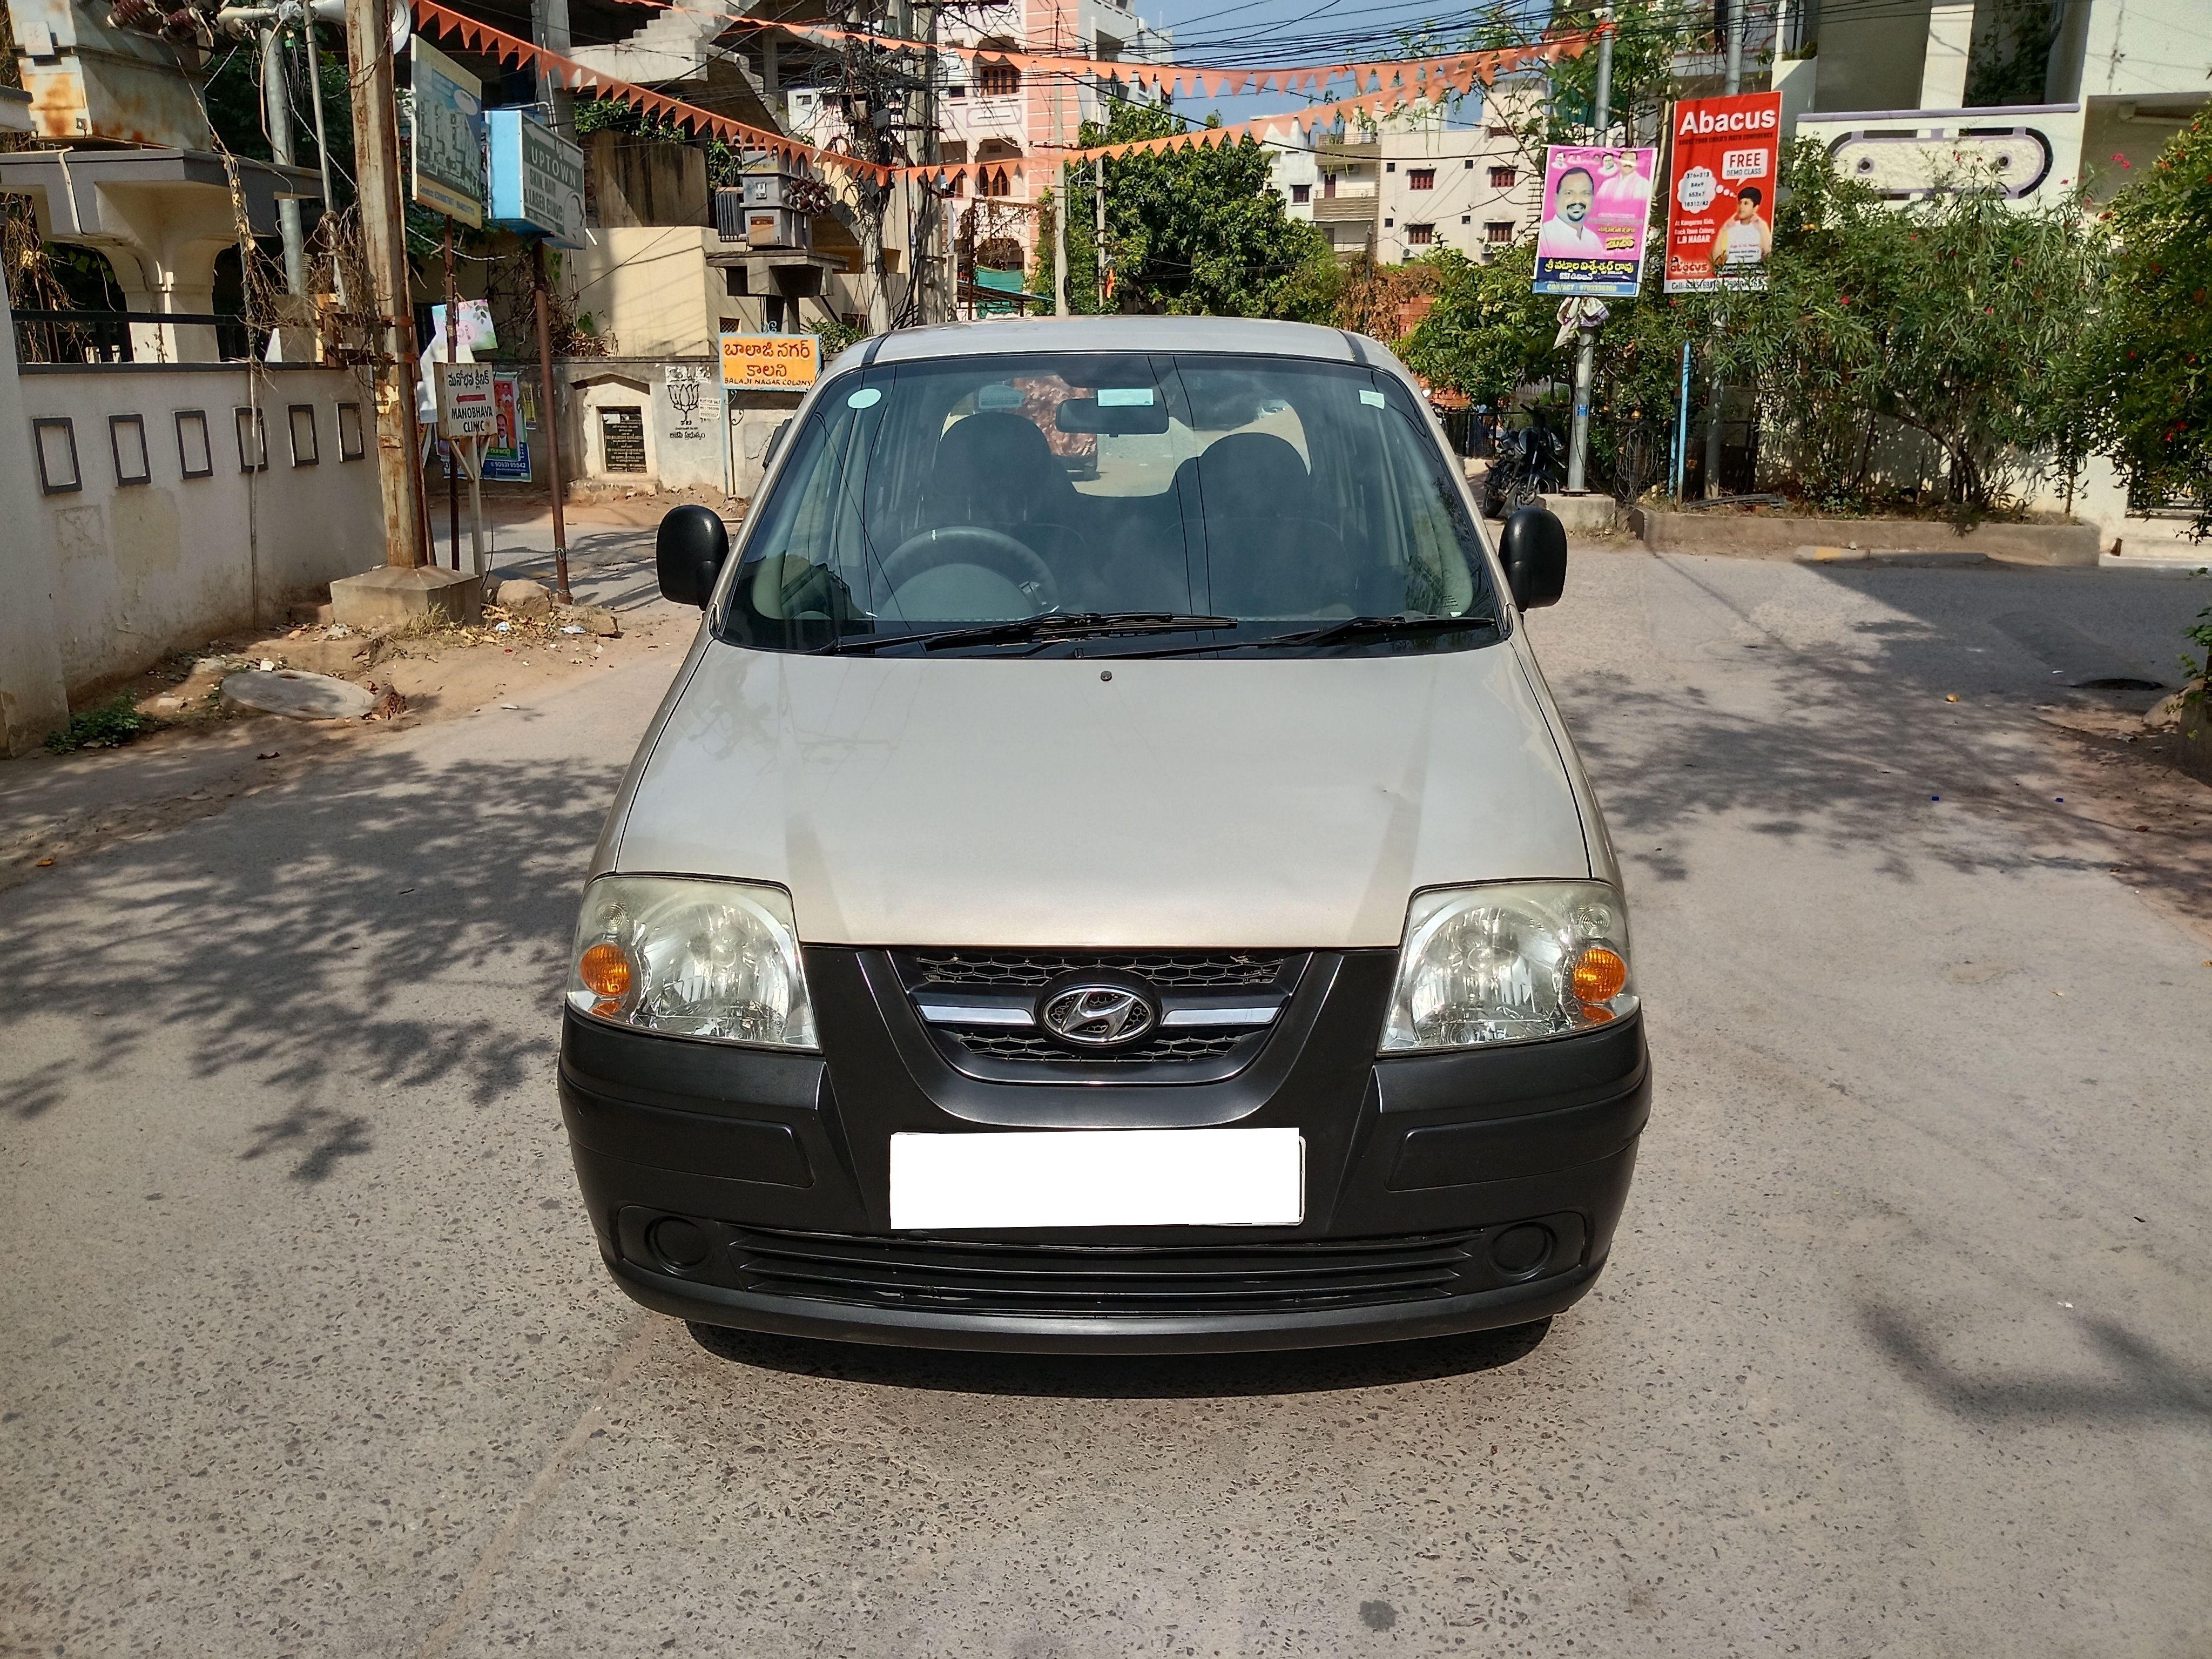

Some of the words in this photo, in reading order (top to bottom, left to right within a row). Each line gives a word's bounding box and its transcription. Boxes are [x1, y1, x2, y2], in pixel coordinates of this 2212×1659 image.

[1679, 110, 1776, 136] Abacus
[531, 146, 576, 187] UPTOWN
[1730, 152, 1761, 168] FREE
[1726, 168, 1743, 177] DEMO
[1744, 167, 1762, 176] CLASS
[1688, 234, 1710, 244] NAGAR
[777, 340, 810, 358] నగర్
[746, 363, 787, 377] కాలని
[451, 405, 493, 420] MANOBHAVA
